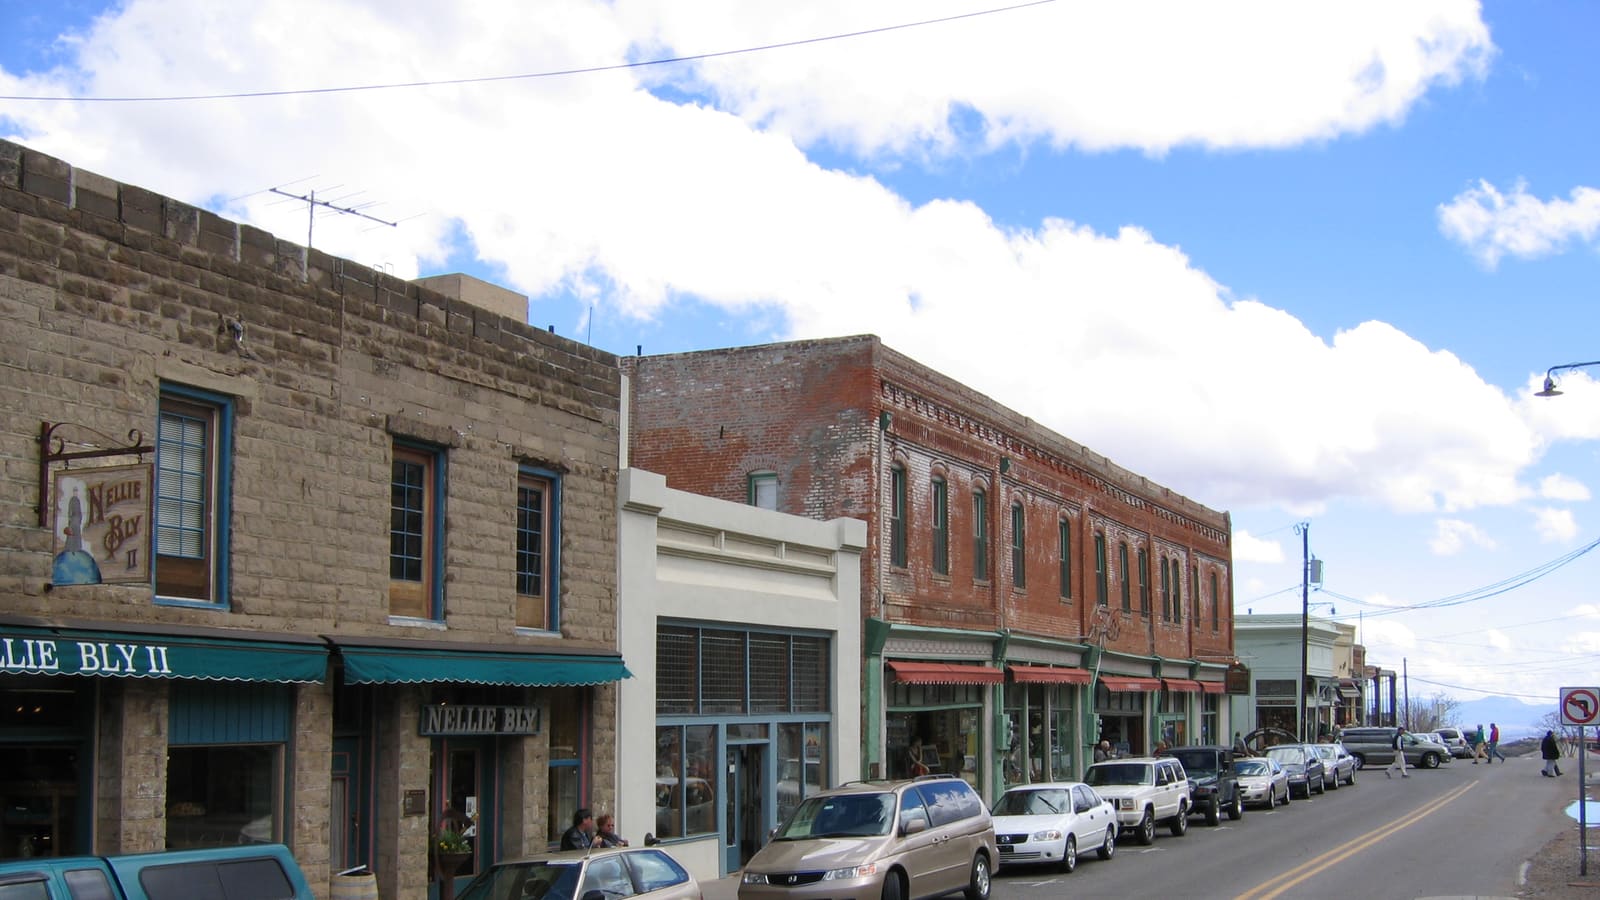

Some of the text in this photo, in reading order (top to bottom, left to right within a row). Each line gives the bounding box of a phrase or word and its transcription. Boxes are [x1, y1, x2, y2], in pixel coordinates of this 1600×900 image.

[87, 479, 141, 527] NELLIE
[103, 514, 142, 560] BLY
[0, 638, 172, 674] LIE BLY II
[426, 706, 538, 733] NELLIE BLY
